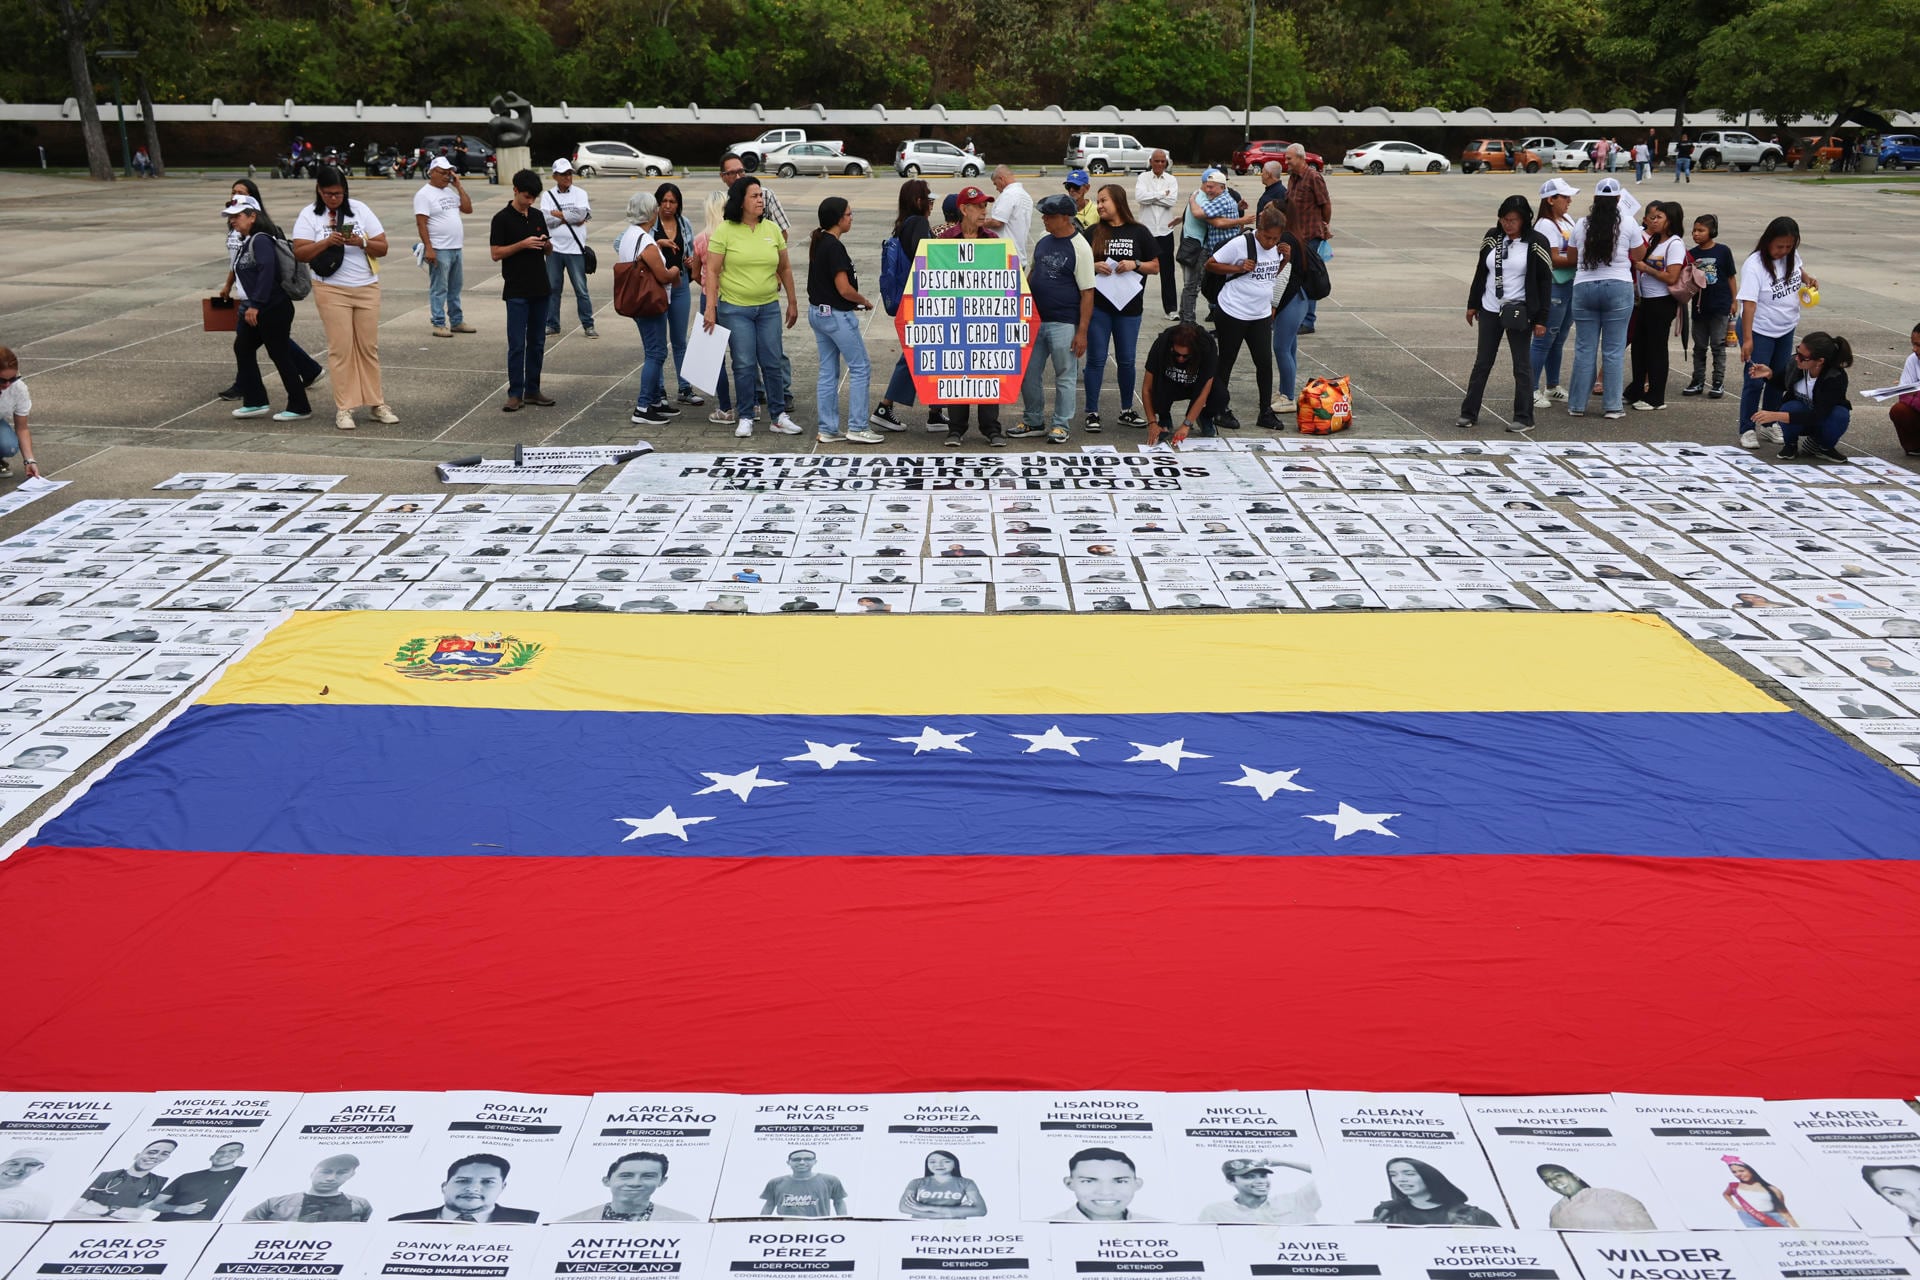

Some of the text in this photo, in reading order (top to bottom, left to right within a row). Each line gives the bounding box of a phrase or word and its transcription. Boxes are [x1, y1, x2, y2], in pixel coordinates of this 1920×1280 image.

[960, 243, 974, 261] NO
[920, 270, 1016, 289] DESCANSAREMOS
[918, 297, 1031, 316] HASTA ABRAZAR A
[906, 324, 1028, 344] TODOS Y CADA UNO
[922, 351, 1014, 370] DE LOS PRESOS
[939, 375, 999, 398] POLÍTICOS
[712, 455, 1179, 467] ESTUDIANTES UNIDOS
[678, 467, 1211, 478] POR LA LIBERTAD DE LOS
[28, 1101, 113, 1110] FREWILL
[340, 1105, 396, 1113] ARLEI
[483, 1104, 548, 1114] ROALMI
[629, 1105, 694, 1113] CARLOS
[22, 1111, 99, 1120] RANGEL
[330, 1114, 396, 1122] ESPITIA
[476, 1112, 543, 1123] CABEZA
[606, 1114, 717, 1123] MARCANO
[1047, 1111, 1145, 1120] HENRÍQUEZ
[1809, 1110, 1880, 1119] KAREN
[1340, 1117, 1445, 1126] COLMENARES
[310, 1125, 406, 1133] VENEZOLANO
[484, 1124, 526, 1132] DETENIDO
[80, 1238, 167, 1248] CARLOS
[571, 1238, 681, 1248] ANTHONY
[748, 1234, 846, 1244] RODRIGO
[911, 1235, 982, 1243] FRANYER
[1099, 1238, 1169, 1247] HÉCTOR
[255, 1240, 333, 1250] BRUNO
[397, 1241, 453, 1250] DANNY
[1278, 1242, 1339, 1250] JAVIER
[69, 1250, 160, 1259] MOCAYO
[567, 1249, 680, 1259] VICENTELLI
[763, 1246, 827, 1257] PÉREZ
[1097, 1250, 1179, 1258] HIDALGO
[1446, 1246, 1517, 1254] YEFREN
[247, 1251, 328, 1261] JUAREZ
[390, 1251, 509, 1263] SOTOMAYOR
[1277, 1253, 1348, 1261] AZUAJE
[1597, 1248, 1724, 1262] WILDER
[565, 1263, 674, 1272] VENEZOLANO
[1778, 1259, 1828, 1267] BLANCA
[61, 1265, 144, 1274] DETENIDO
[225, 1264, 335, 1274] VENEZOLANO
[385, 1266, 506, 1275] DETENIDO INJUSTAMENTE
[1798, 1268, 1896, 1277] FAMILIA DETENIDA
[1607, 1268, 1737, 1280] VASQUEZ
